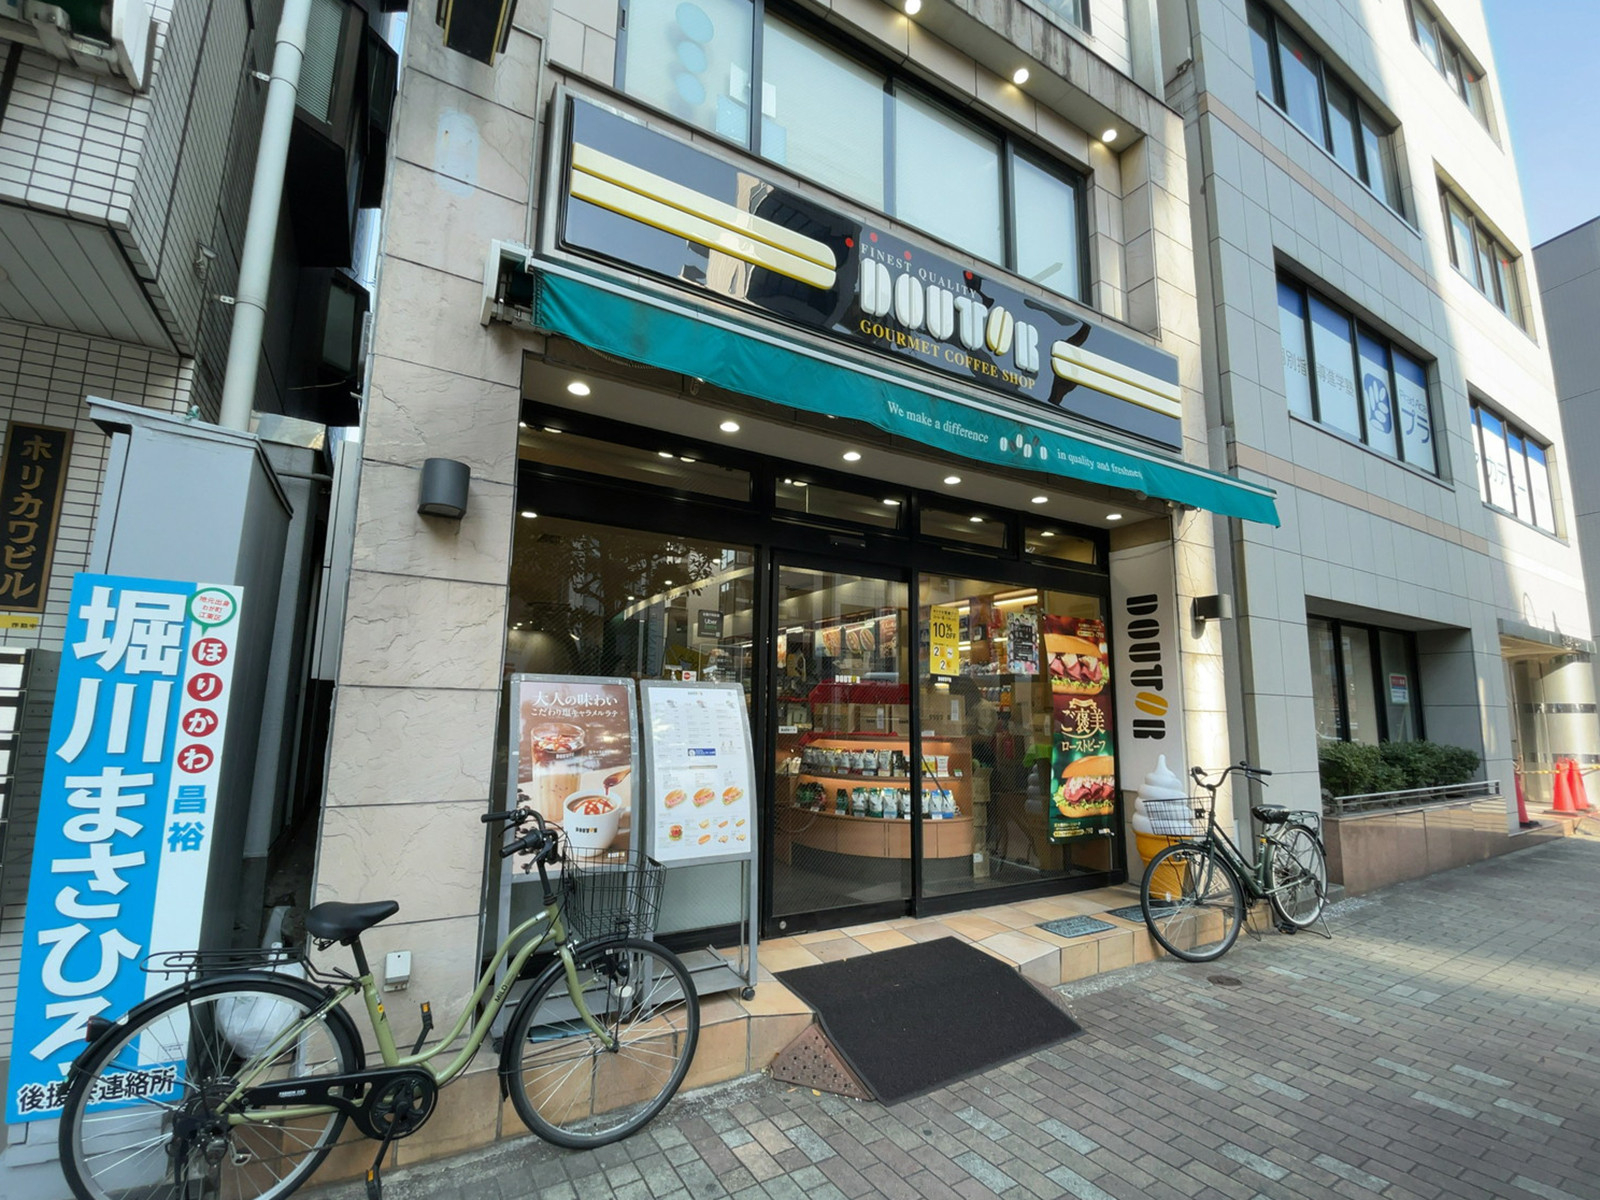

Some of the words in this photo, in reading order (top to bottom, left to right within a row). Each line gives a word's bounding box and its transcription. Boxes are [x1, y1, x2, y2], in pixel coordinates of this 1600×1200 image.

[861, 243, 912, 273] FINEST
[918, 267, 977, 299] QUALITY
[860, 257, 1040, 373] DOUTOR
[860, 319, 940, 358] GOURMET
[944, 350, 998, 378] COFFEE
[1002, 369, 1036, 390] SHOP
[887, 400, 905, 417] We
[906, 410, 933, 427] make
[934, 420, 941, 430] a
[943, 420, 989, 443] difference
[1057, 448, 1067, 460] in
[1068, 453, 1094, 470] quality
[1096, 461, 1110, 472] and
[0, 434, 53, 600] ホリカワビル
[1126, 593, 1169, 740] DOUTOR
[532, 690, 619, 707] 大人の味わい
[1061, 708, 1106, 734] ご褒美
[1061, 738, 1106, 753] ローストビーフ
[167, 784, 210, 853] 昌裕
[18, 1067, 177, 1114] 後援連絡所
